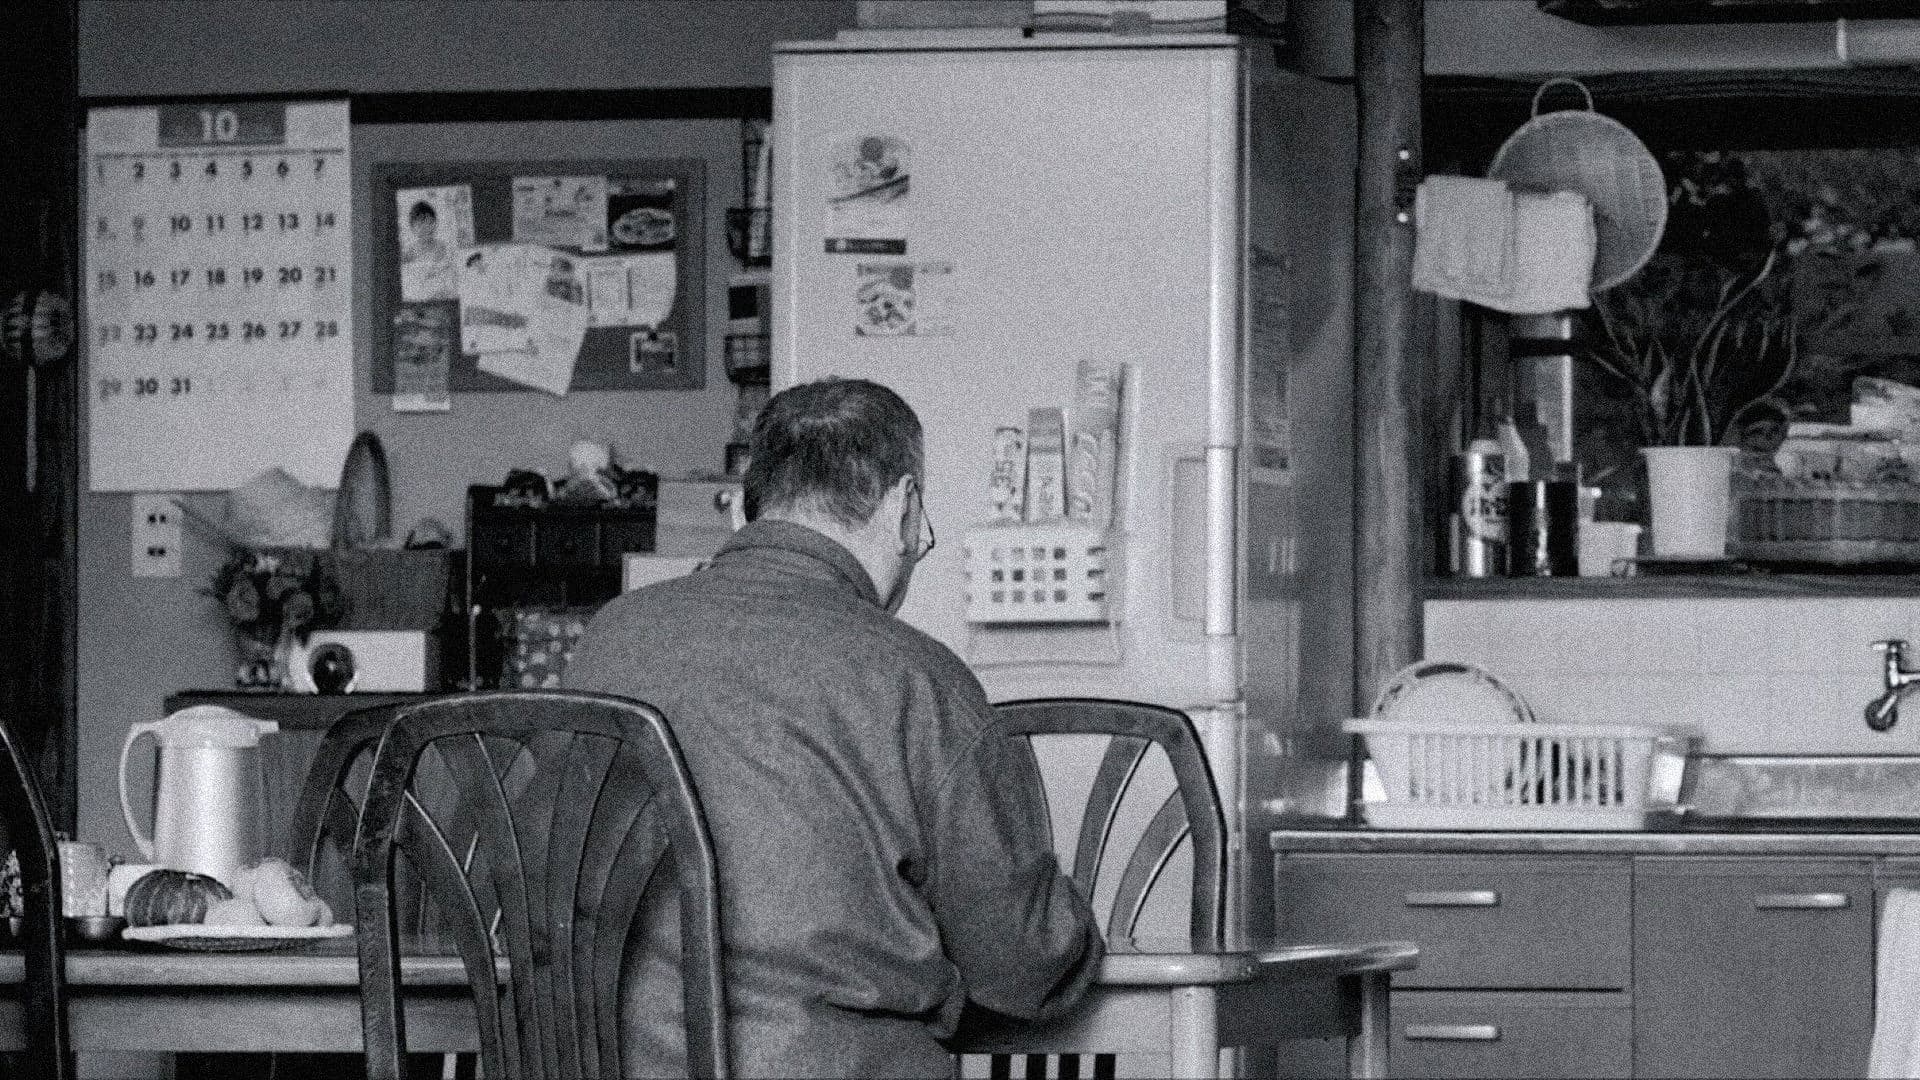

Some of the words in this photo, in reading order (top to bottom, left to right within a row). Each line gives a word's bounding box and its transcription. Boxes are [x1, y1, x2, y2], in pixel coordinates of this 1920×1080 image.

[200, 110, 239, 142] 10
[132, 162, 145, 179] 2
[170, 161, 181, 180] 3
[205, 160, 218, 177] 4
[242, 161, 252, 178] 5
[277, 161, 289, 178] 6
[314, 159, 324, 174] 7
[170, 215, 191, 231] 10
[207, 215, 224, 230] 11
[242, 214, 264, 230] 12
[279, 213, 299, 230] 13
[316, 214, 335, 228] 14
[134, 270, 155, 287] 16
[171, 270, 190, 286] 17
[207, 268, 226, 284] 18
[243, 268, 264, 284] 19
[279, 267, 302, 284] 20
[314, 267, 336, 283] 21
[134, 324, 157, 341] 23
[170, 324, 194, 340] 24
[207, 322, 229, 339] 25
[242, 322, 266, 339] 26
[279, 321, 302, 338] 27
[315, 321, 338, 338] 28
[135, 378, 158, 394] 30
[170, 378, 191, 394] 31
